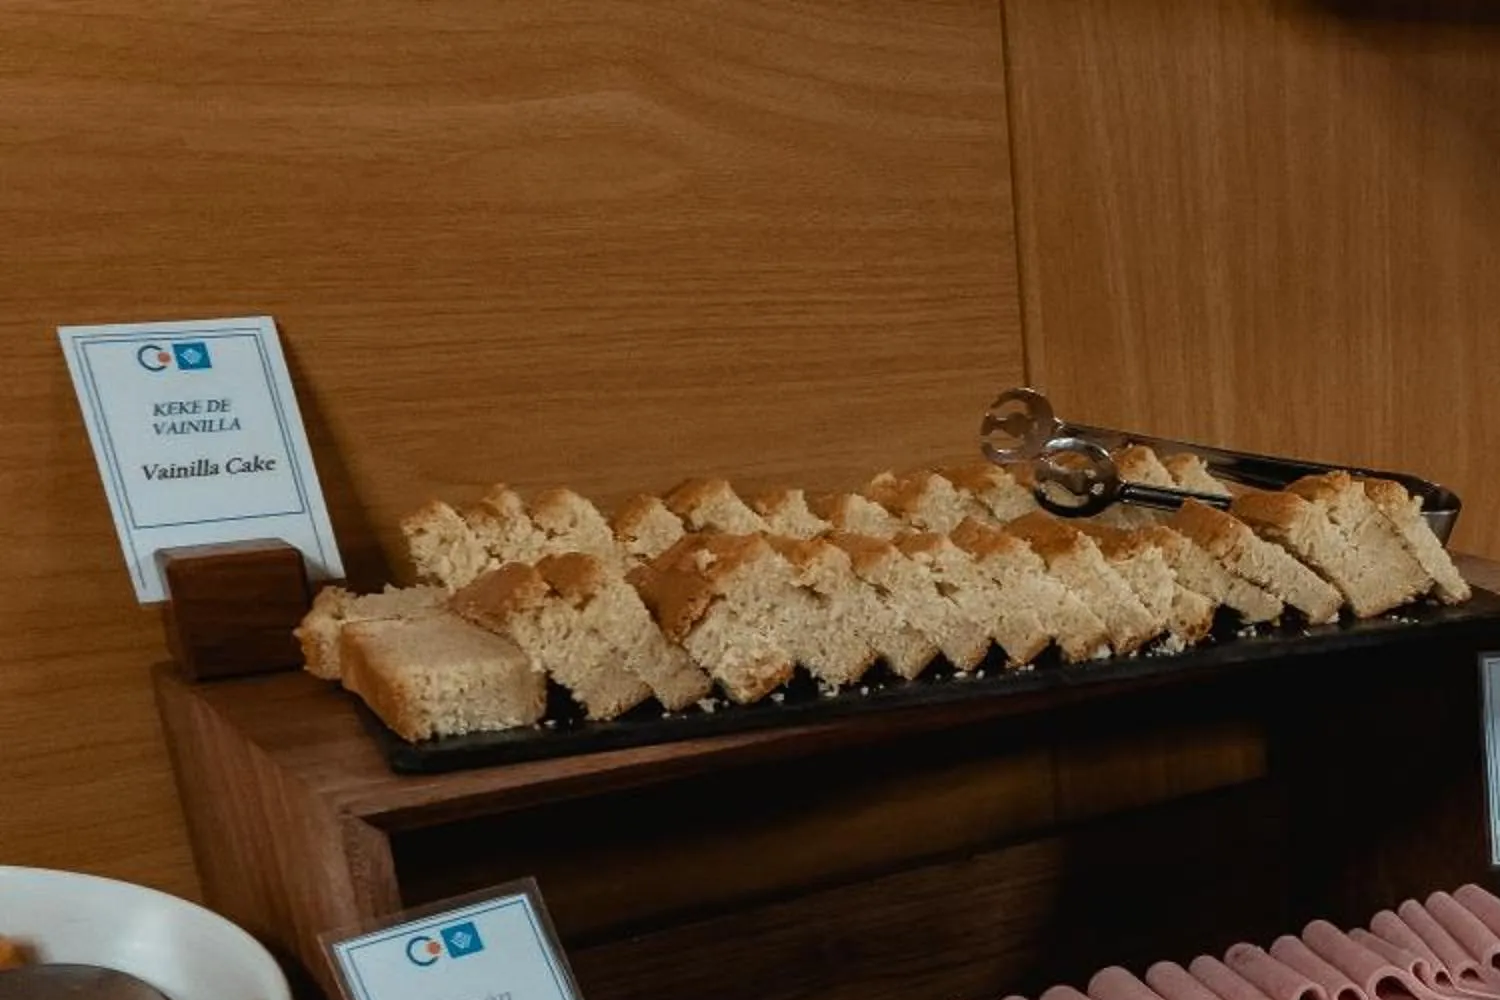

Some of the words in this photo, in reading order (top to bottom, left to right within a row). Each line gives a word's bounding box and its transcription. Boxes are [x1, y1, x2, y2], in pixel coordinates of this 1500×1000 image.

[152, 400, 201, 416] KEKE
[206, 399, 231, 413] DE
[153, 418, 241, 434] VAINILLA
[143, 460, 220, 480] Vainilla
[225, 456, 276, 475] Cake
